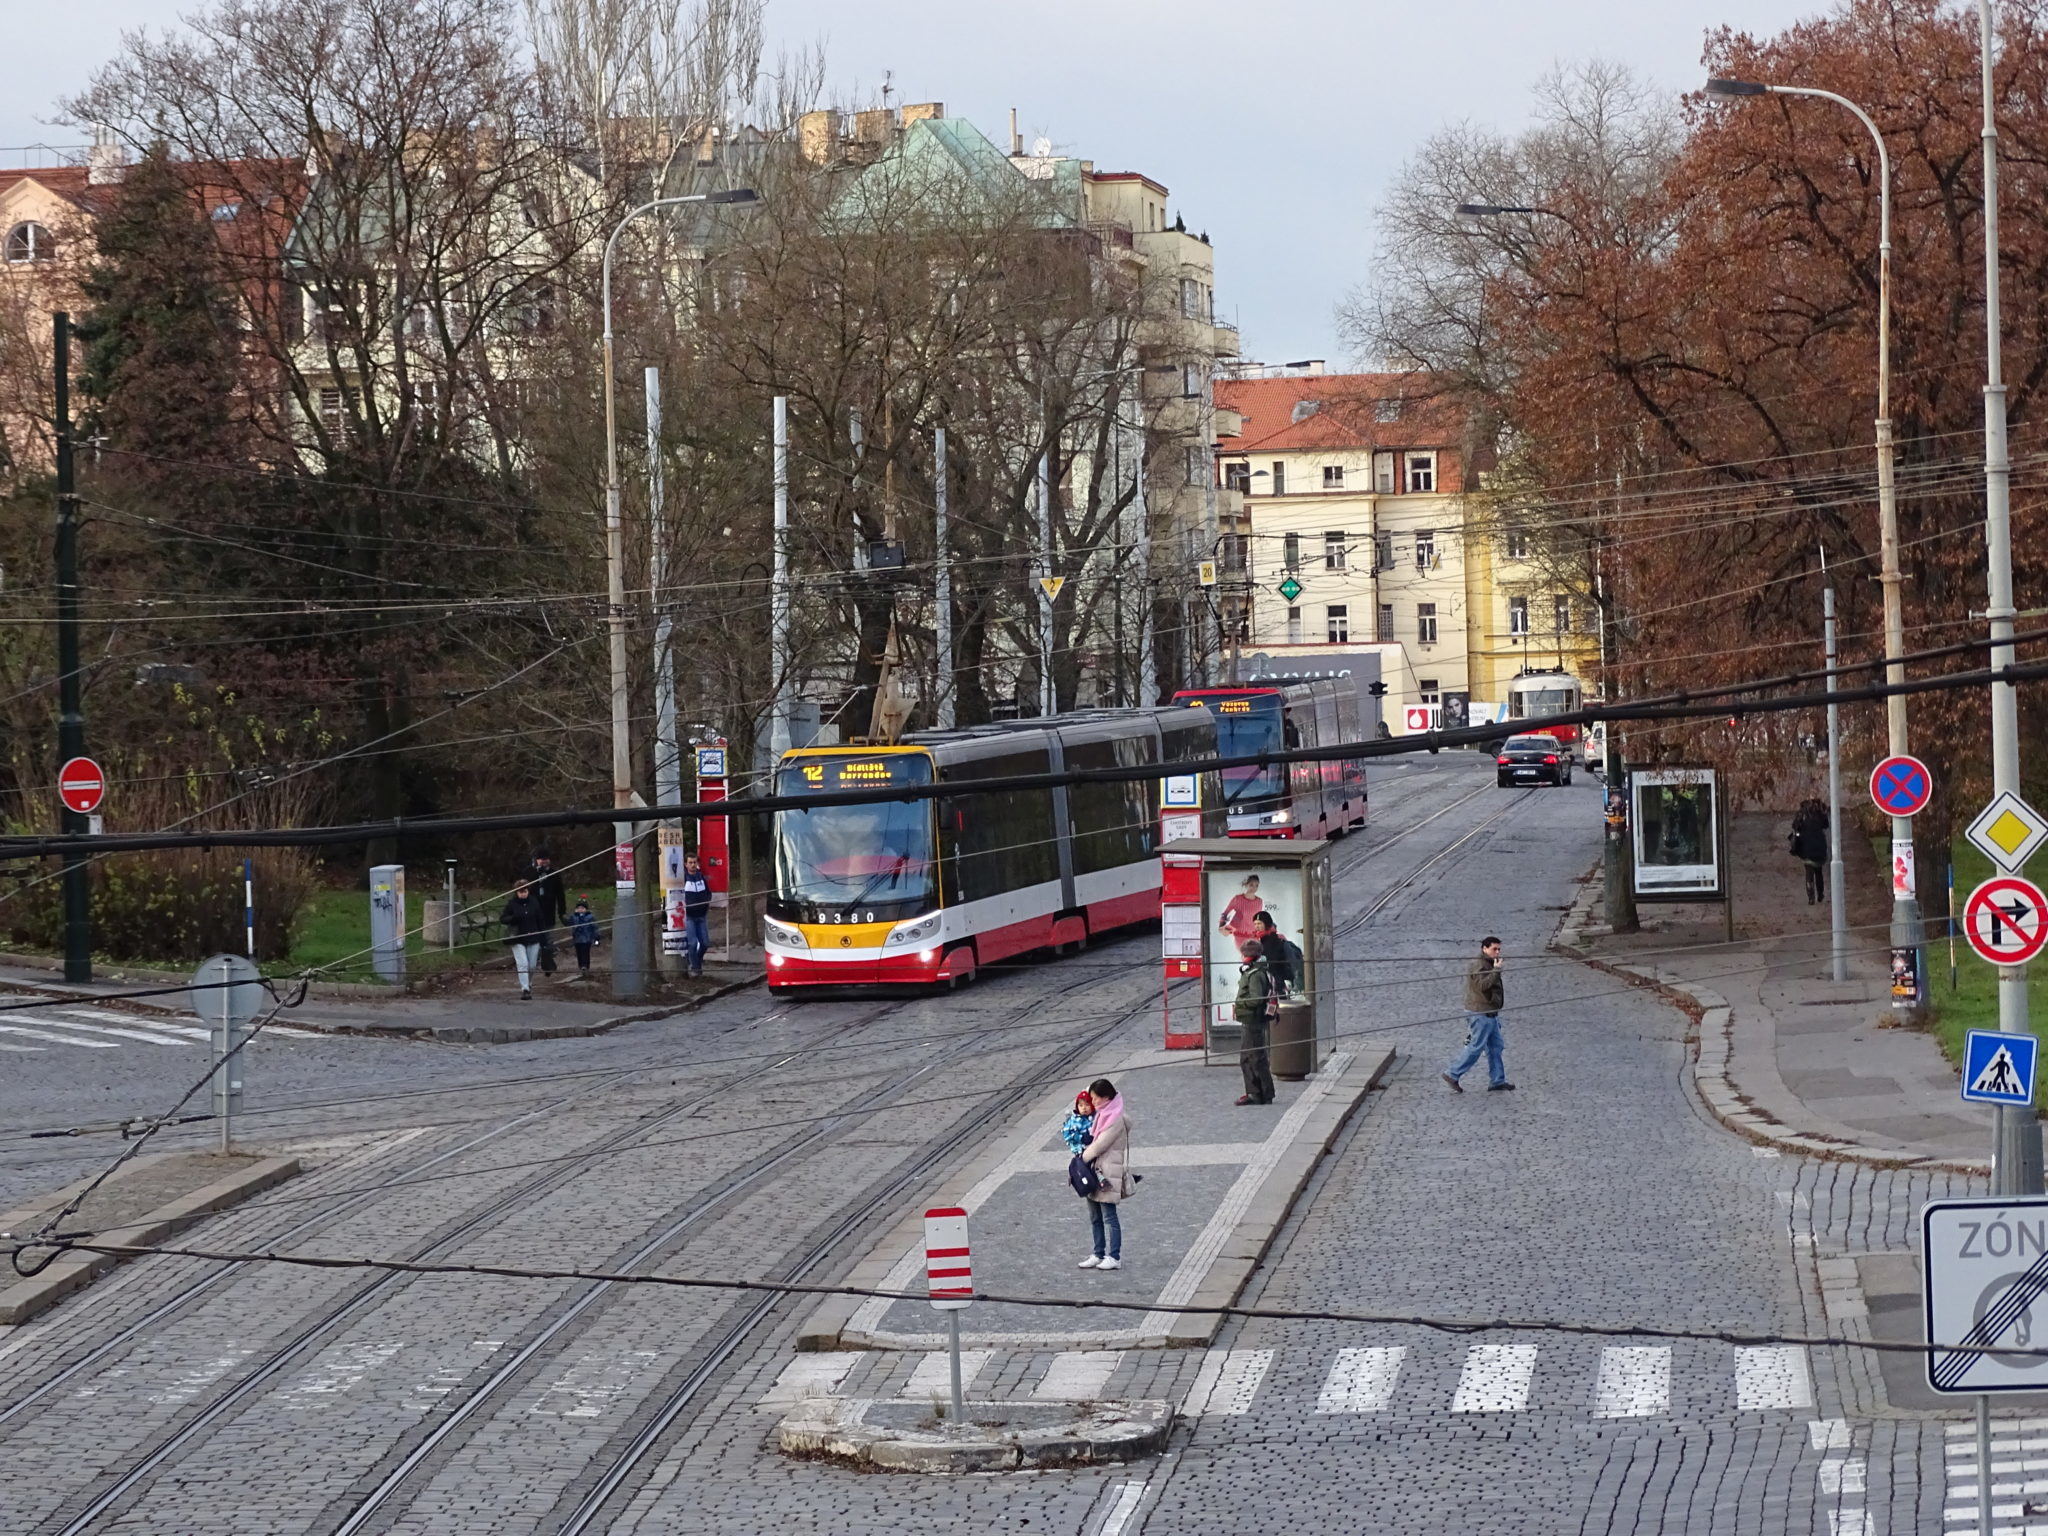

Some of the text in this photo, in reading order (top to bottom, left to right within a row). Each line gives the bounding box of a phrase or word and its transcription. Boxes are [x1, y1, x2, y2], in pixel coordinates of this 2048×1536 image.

[1203, 568, 1212, 577] 20
[803, 765, 823, 781] 12
[818, 912, 874, 924] 9380
